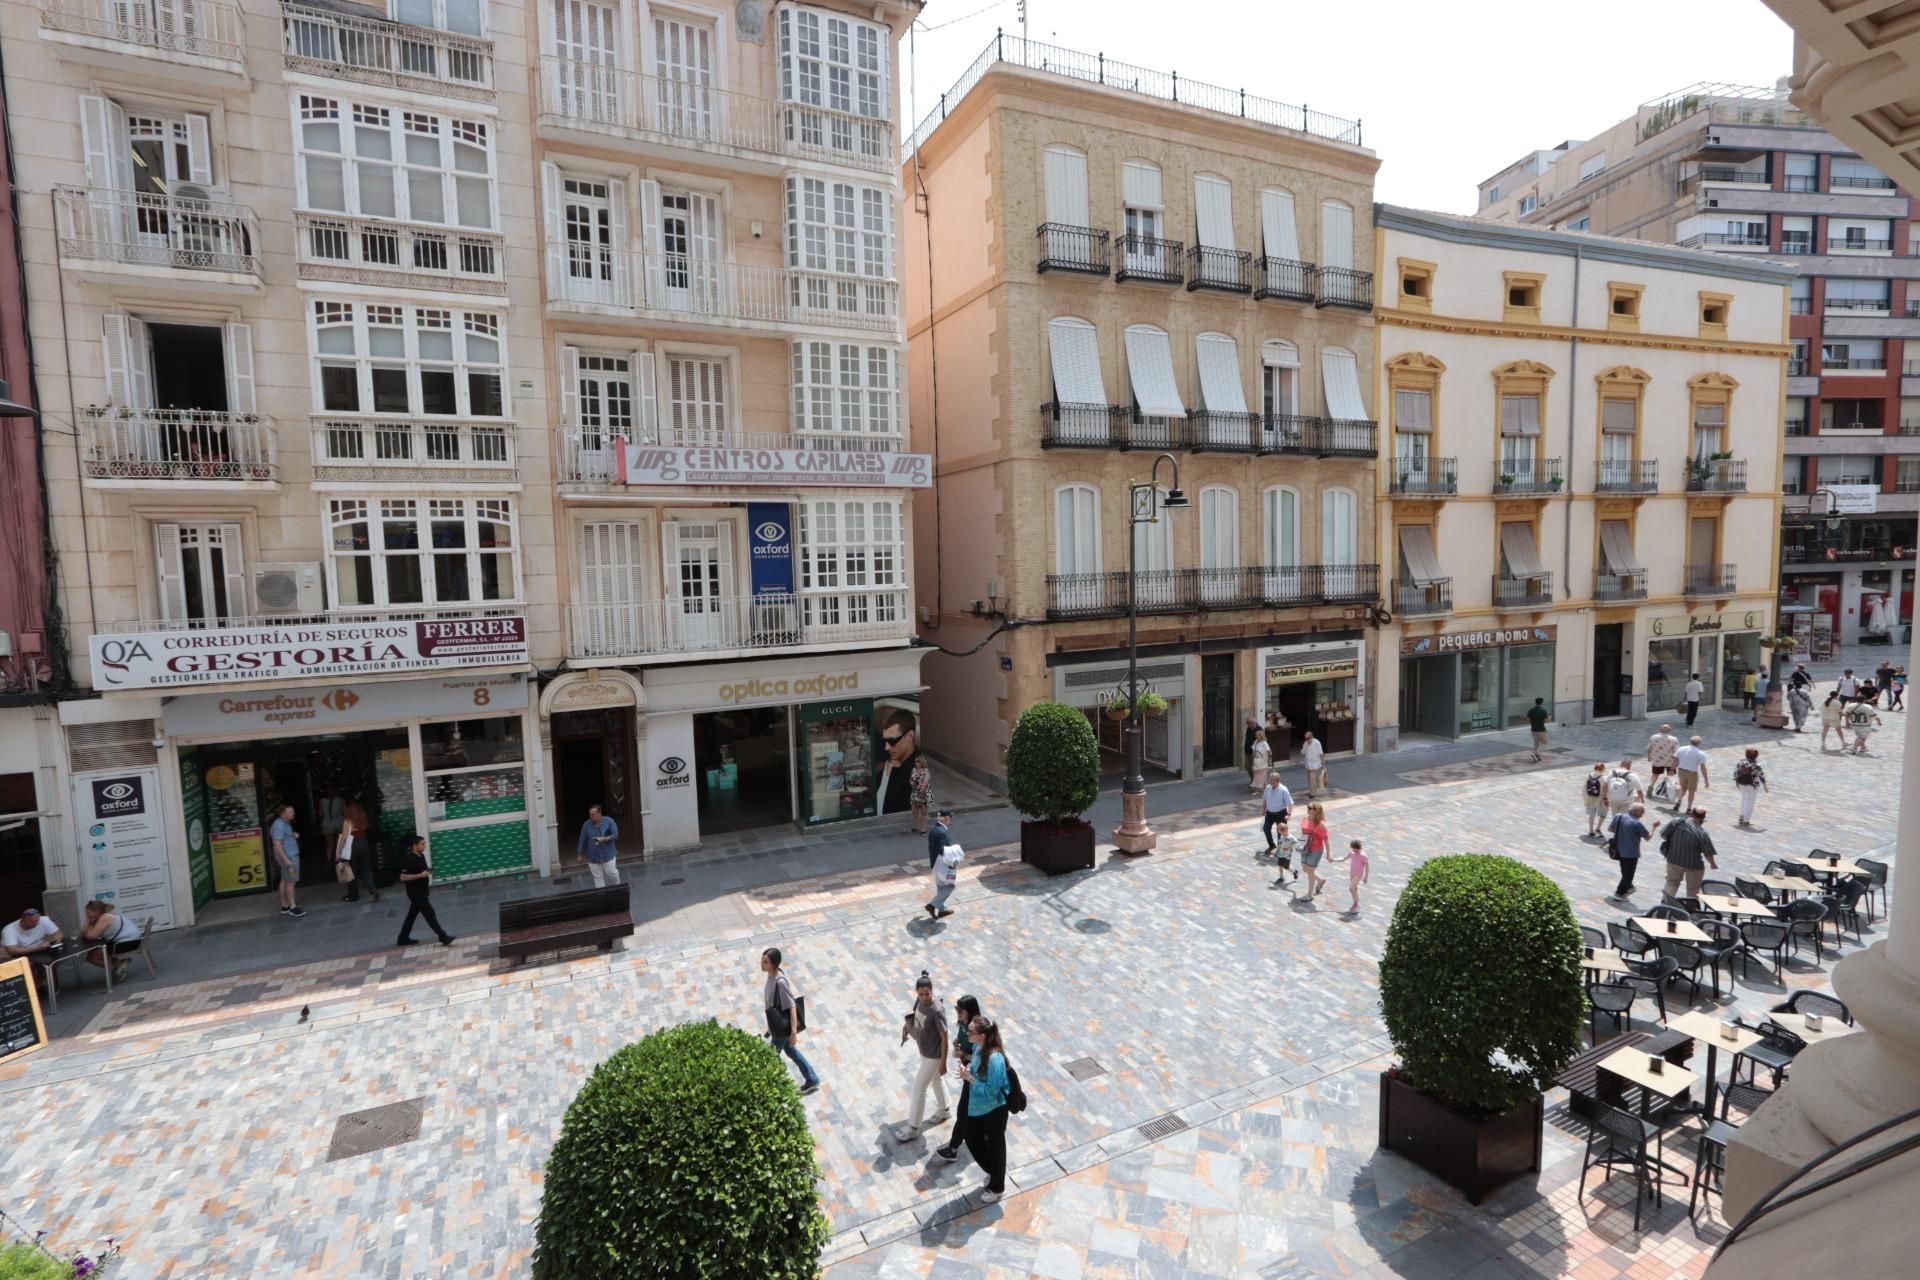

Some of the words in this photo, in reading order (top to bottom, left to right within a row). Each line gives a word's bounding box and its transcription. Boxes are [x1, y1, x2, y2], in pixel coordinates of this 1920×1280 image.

[684, 449, 785, 471] CENTROS
[795, 452, 886, 473] CAPILARES
[753, 544, 789, 554] oxford
[163, 630, 292, 650] CORREDURÍA
[298, 630, 322, 643] DE
[326, 626, 408, 642] SEGUROS
[423, 620, 518, 638] FERRER
[1439, 631, 1491, 651] pequeña
[1495, 629, 1528, 642] moma
[166, 641, 408, 673] GESTORÍA
[150, 673, 211, 684] GESTIONES
[216, 671, 229, 680] EN
[390, 661, 402, 669] DE
[406, 659, 440, 667] FINCAS
[458, 654, 521, 665] INMOBILIARIA
[473, 687, 490, 706] 8
[719, 679, 789, 703] optica
[793, 672, 859, 695] oxford
[219, 695, 316, 714] Carrefour
[821, 705, 853, 715] GUCCI
[264, 709, 317, 725] express
[656, 773, 690, 787] oxford
[101, 798, 139, 810] oxford
